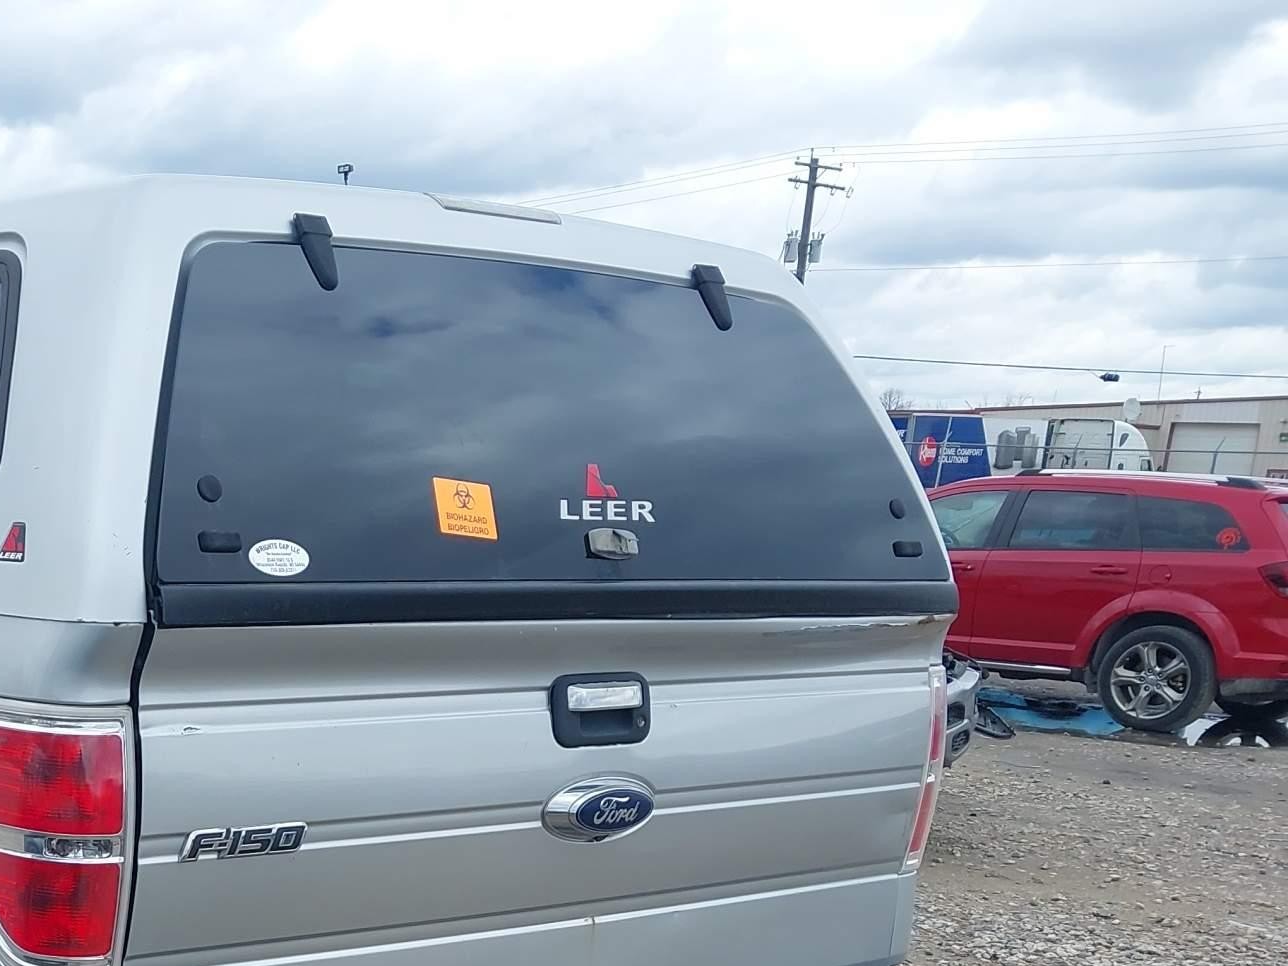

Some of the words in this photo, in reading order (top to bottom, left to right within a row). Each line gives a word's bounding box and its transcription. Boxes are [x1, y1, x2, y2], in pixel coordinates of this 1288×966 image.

[957, 448, 983, 456] COMFORT
[938, 455, 969, 464] SOLUTIONS
[446, 511, 488, 525] BIOHAZARD
[560, 499, 656, 523] LEER
[447, 522, 489, 536] BIOPELIGRO
[0, 551, 24, 561] LEER
[593, 796, 641, 825] Ford
[178, 821, 309, 863] F-150
